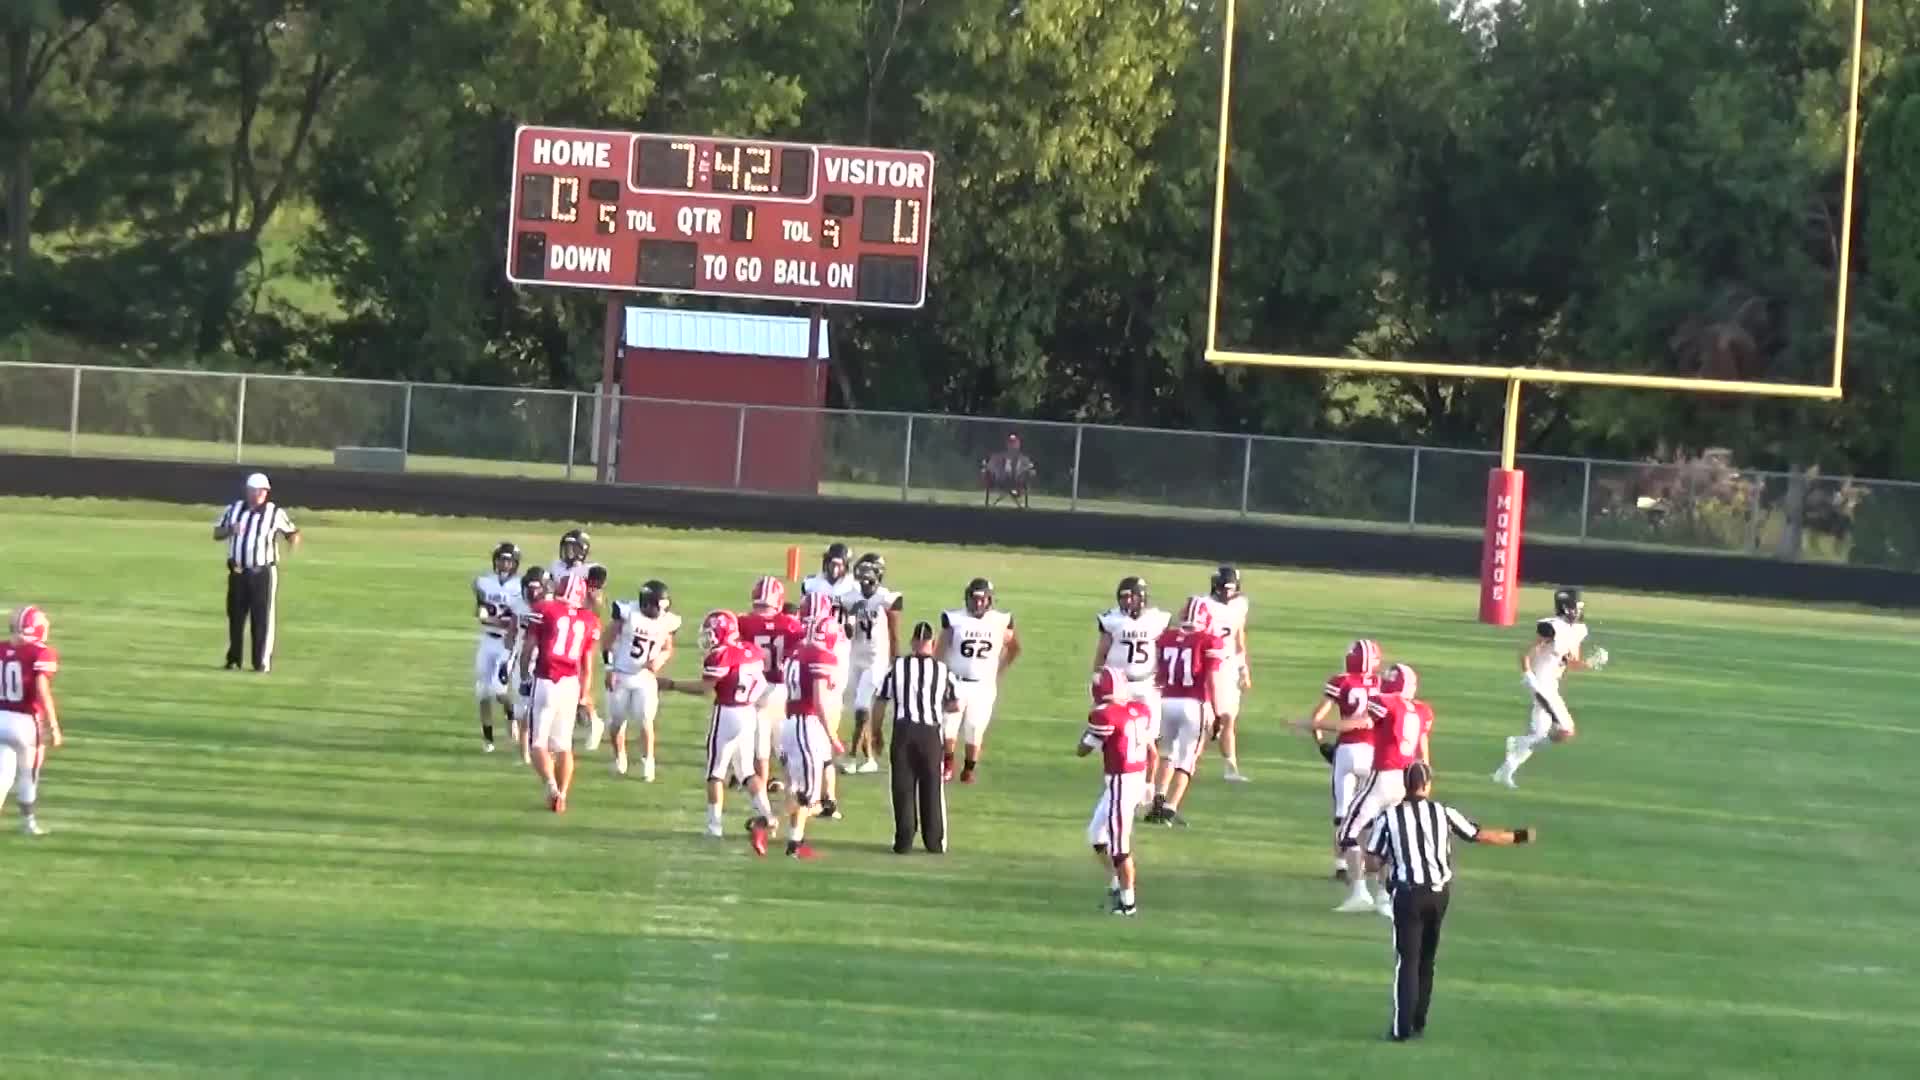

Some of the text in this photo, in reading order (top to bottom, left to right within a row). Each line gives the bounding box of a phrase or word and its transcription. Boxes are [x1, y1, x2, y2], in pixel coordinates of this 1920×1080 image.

[533, 138, 611, 168] HOME
[823, 157, 925, 188] VISITOR
[626, 210, 656, 232] TOL
[677, 207, 722, 234] QTR
[745, 211, 753, 240] 1
[782, 219, 812, 243] TOL
[550, 245, 612, 273] DOWN
[703, 254, 762, 283] TO GO
[774, 259, 854, 289] BALL ON
[1493, 495, 1511, 600] MONROE
[552, 616, 585, 660] 11
[960, 639, 993, 659] 62
[1119, 641, 1149, 664] 75
[1163, 647, 1194, 687] 71
